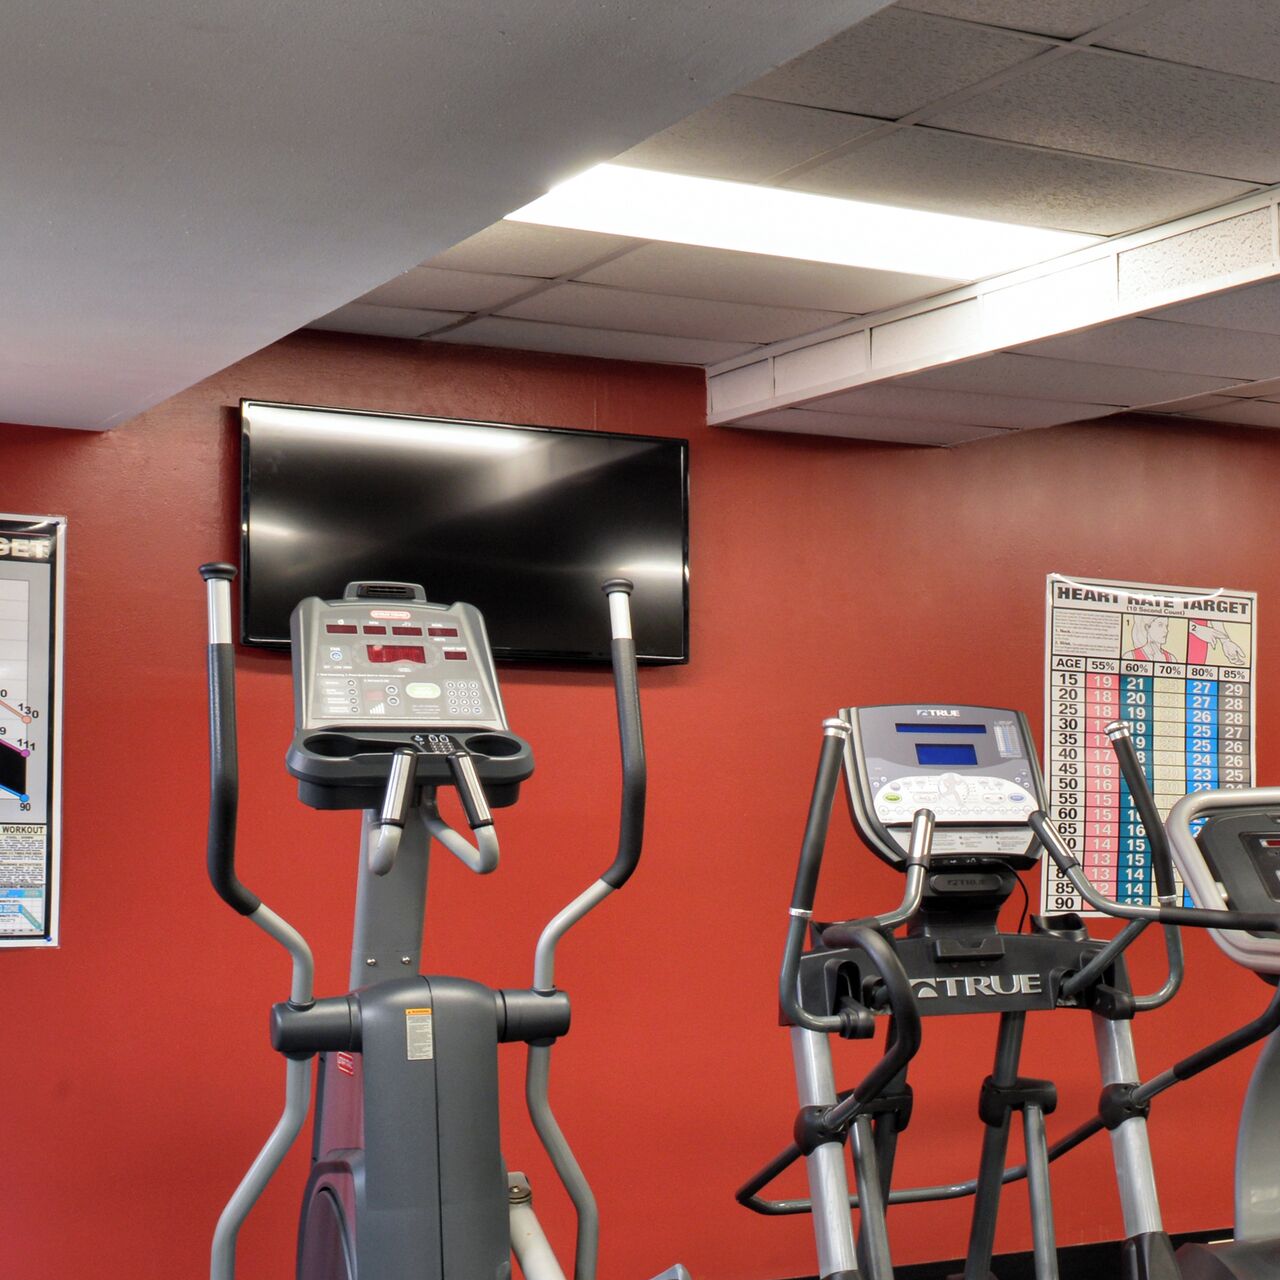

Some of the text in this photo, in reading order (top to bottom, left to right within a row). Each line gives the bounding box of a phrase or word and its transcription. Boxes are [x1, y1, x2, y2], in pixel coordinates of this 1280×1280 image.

[1057, 586, 1120, 604] HEART
[1191, 624, 1197, 632] 2
[1056, 659, 1245, 680] AGE 55% 60% 70% 80% 85%
[1059, 673, 1243, 696] 15 19 21 27 29
[1058, 688, 1078, 700] 20
[1094, 690, 1112, 702] 18
[1126, 692, 1146, 705] 20
[1193, 696, 1211, 708] 27
[1225, 698, 1243, 710] 28
[18, 703, 39, 718] 130
[928, 709, 960, 717] TRUE
[1058, 703, 1078, 715] 25
[1094, 705, 1112, 717] 18
[1128, 707, 1146, 719] 19
[1193, 710, 1211, 722] 26
[1225, 712, 1243, 724] 28
[1058, 718, 1078, 730] 30
[1193, 725, 1211, 737] 25
[1225, 727, 1243, 739] 27
[17, 739, 36, 751] 111
[1058, 733, 1078, 745] 35
[1193, 739, 1211, 752] 25
[1225, 741, 1243, 753] 26
[1058, 748, 1078, 760] 40
[1094, 750, 1112, 762] 17
[1193, 754, 1211, 766] 24
[1225, 756, 1243, 767] 26
[1058, 763, 1078, 775] 45
[1094, 764, 1112, 776] 16
[1193, 768, 1211, 780] 23
[1225, 769, 1243, 781] 25
[1058, 778, 1078, 790] 50
[1094, 779, 1112, 790] 16
[1058, 793, 1078, 805] 55
[1094, 794, 1112, 806] 15
[20, 803, 31, 811] 90
[1058, 807, 1077, 820] 60
[1094, 809, 1112, 821] 15
[2, 826, 44, 834] WORKOUT
[1058, 823, 1077, 835] 65
[1094, 824, 1112, 836] 14
[1127, 824, 1146, 836] 16
[1094, 839, 1111, 850] 14
[1127, 839, 1145, 851] 15
[1092, 853, 1144, 865] 13 15
[1091, 868, 1110, 879] 13
[1126, 869, 1144, 880] 14
[1056, 882, 1075, 894] 85
[1125, 883, 1143, 895] 14
[1055, 897, 1074, 909] 90
[937, 974, 1042, 997] TRUE
